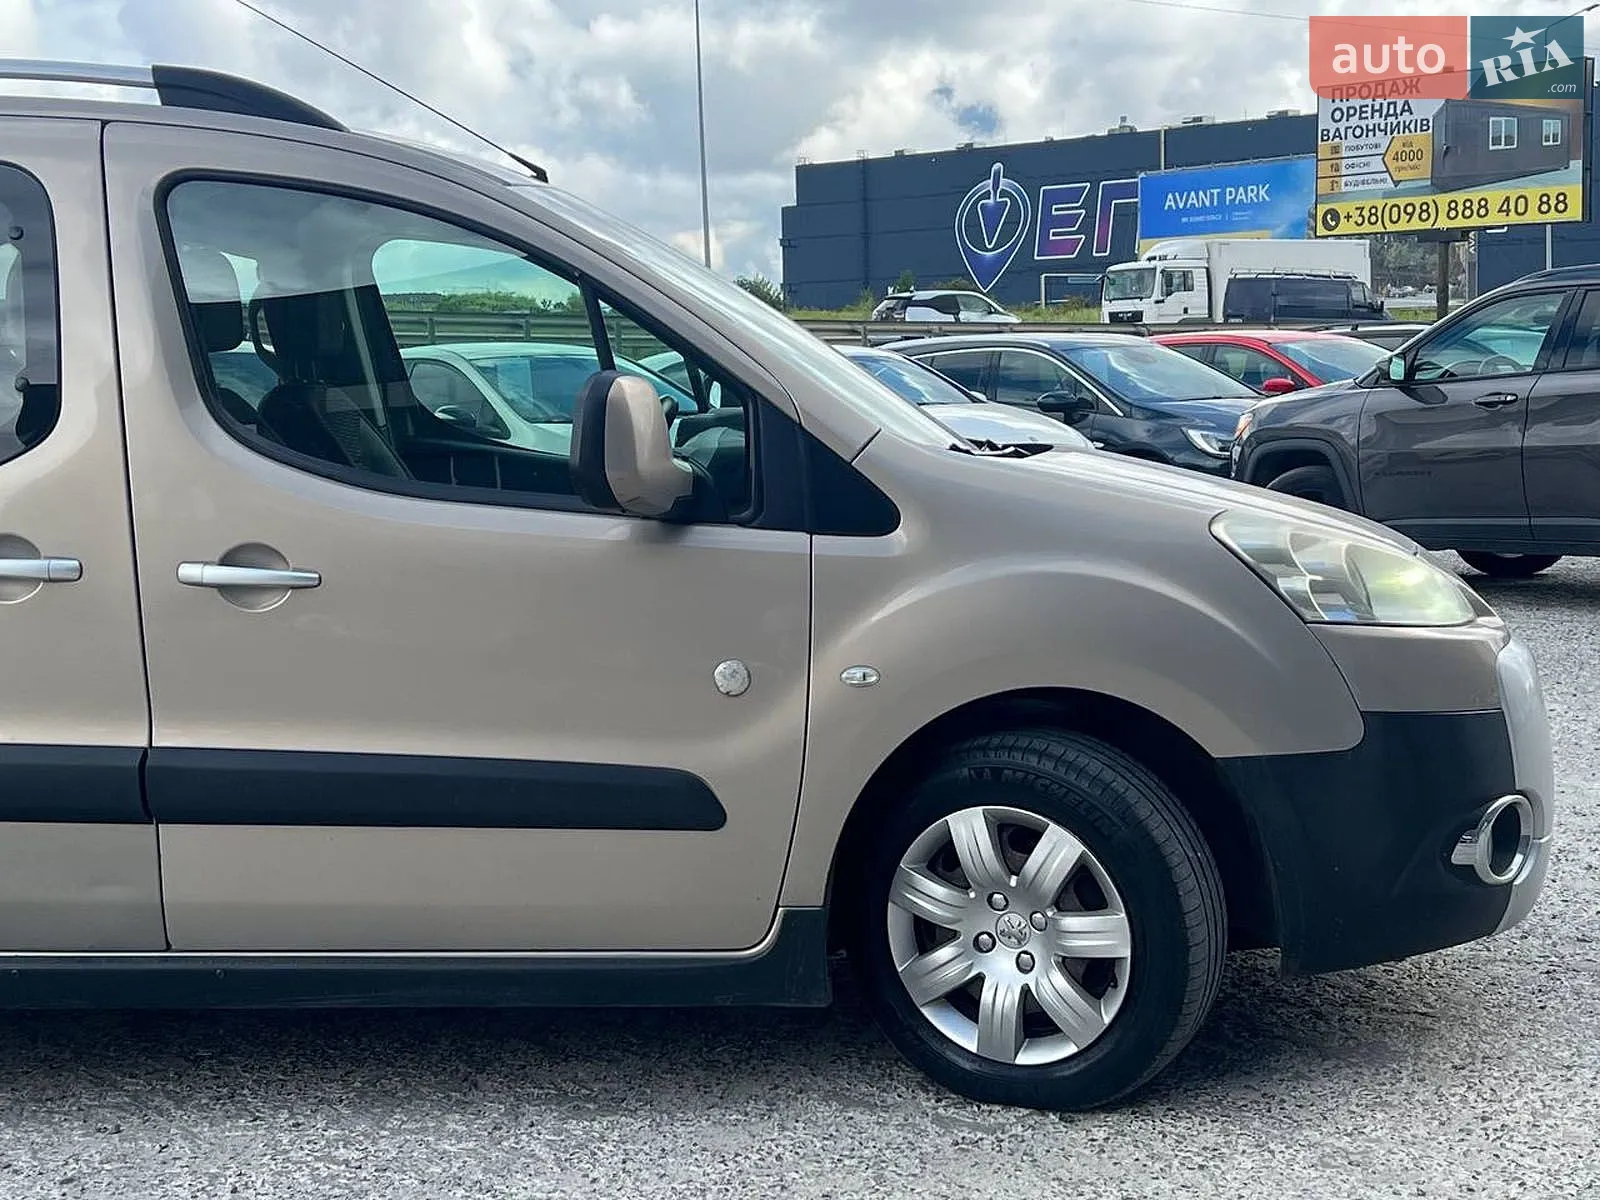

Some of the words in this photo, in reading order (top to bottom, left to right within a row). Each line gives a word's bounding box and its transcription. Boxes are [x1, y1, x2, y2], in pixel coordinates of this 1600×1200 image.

[1331, 78, 1420, 103] ПРОДАЖ
[1330, 100, 1414, 123] ОРЕНДА
[1320, 118, 1431, 142] ВАГОНЧИКІВ
[1392, 148, 1424, 162] 4000
[1164, 188, 1222, 211] AVANT
[1225, 183, 1271, 206] PARK
[1343, 198, 1439, 229] +38(098)
[1446, 197, 1490, 221] 888
[1497, 194, 1529, 217] 40
[1537, 191, 1569, 215] 88
